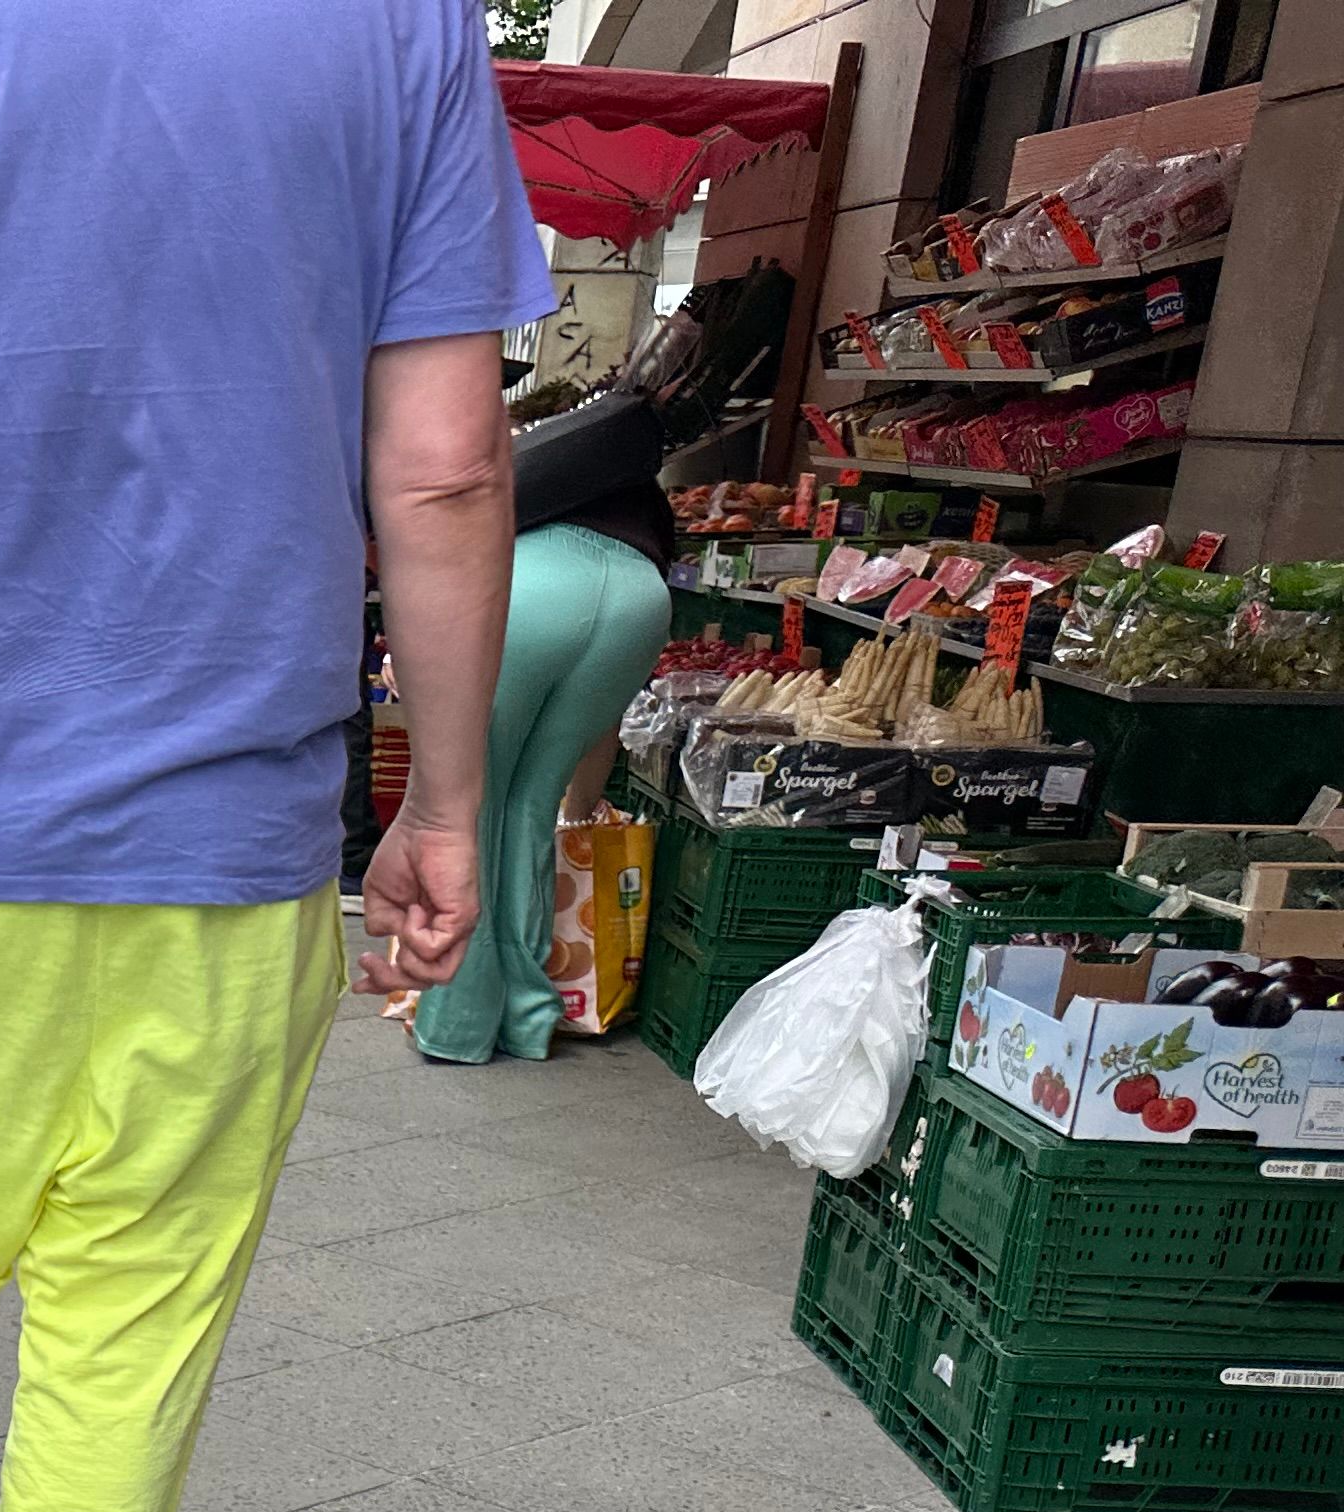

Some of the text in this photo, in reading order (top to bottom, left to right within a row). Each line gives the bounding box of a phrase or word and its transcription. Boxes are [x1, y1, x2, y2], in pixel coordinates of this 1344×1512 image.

[774, 766, 858, 797] Spargel
[953, 776, 1041, 805] Spargel
[1213, 1070, 1285, 1089] Harvest
[1223, 1088, 1300, 1105] of health
